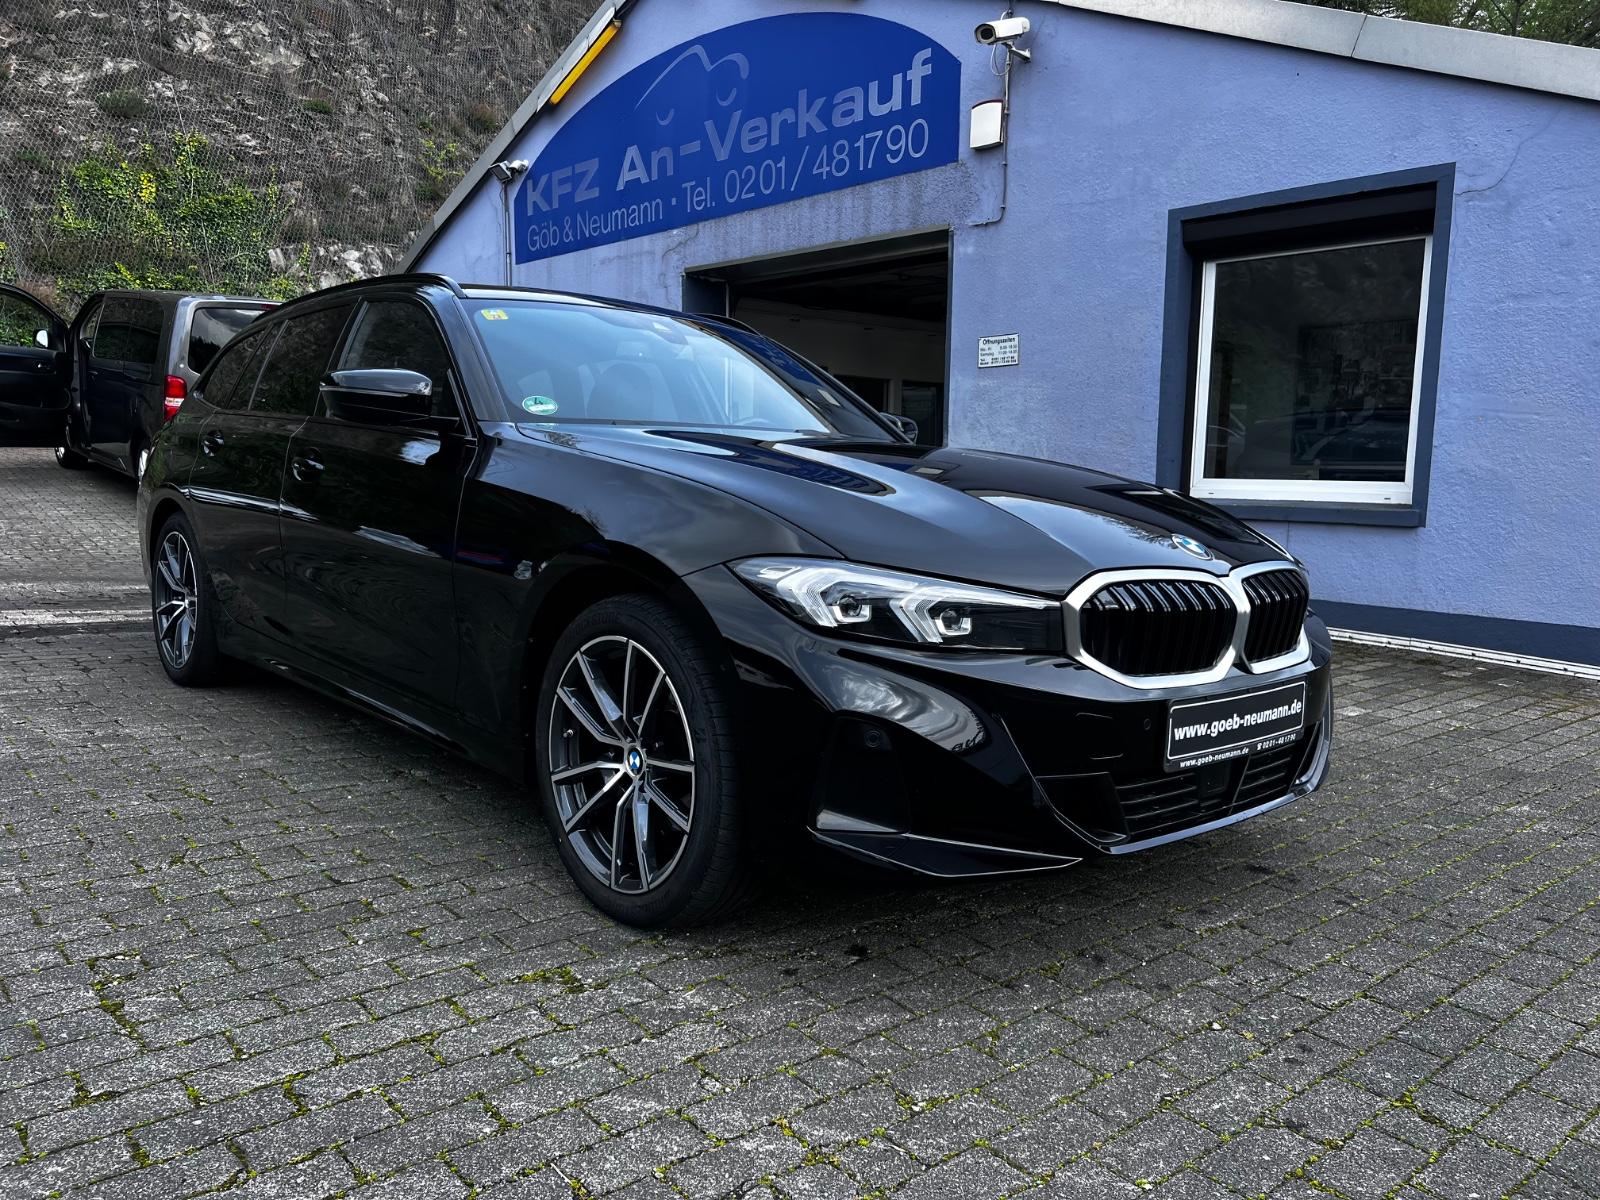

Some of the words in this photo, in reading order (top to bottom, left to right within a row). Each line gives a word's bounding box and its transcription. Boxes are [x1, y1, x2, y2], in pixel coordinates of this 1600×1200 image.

[526, 158, 599, 217] KFZ
[616, 48, 932, 191] An-Verkauf
[527, 221, 560, 252] Göb
[563, 217, 574, 242] &
[577, 198, 663, 240] Neumann
[682, 180, 716, 213] Tel.
[1174, 699, 1302, 741] www.goeb-neumann.de
[1180, 747, 1249, 768] www.goeb-neumann.de
